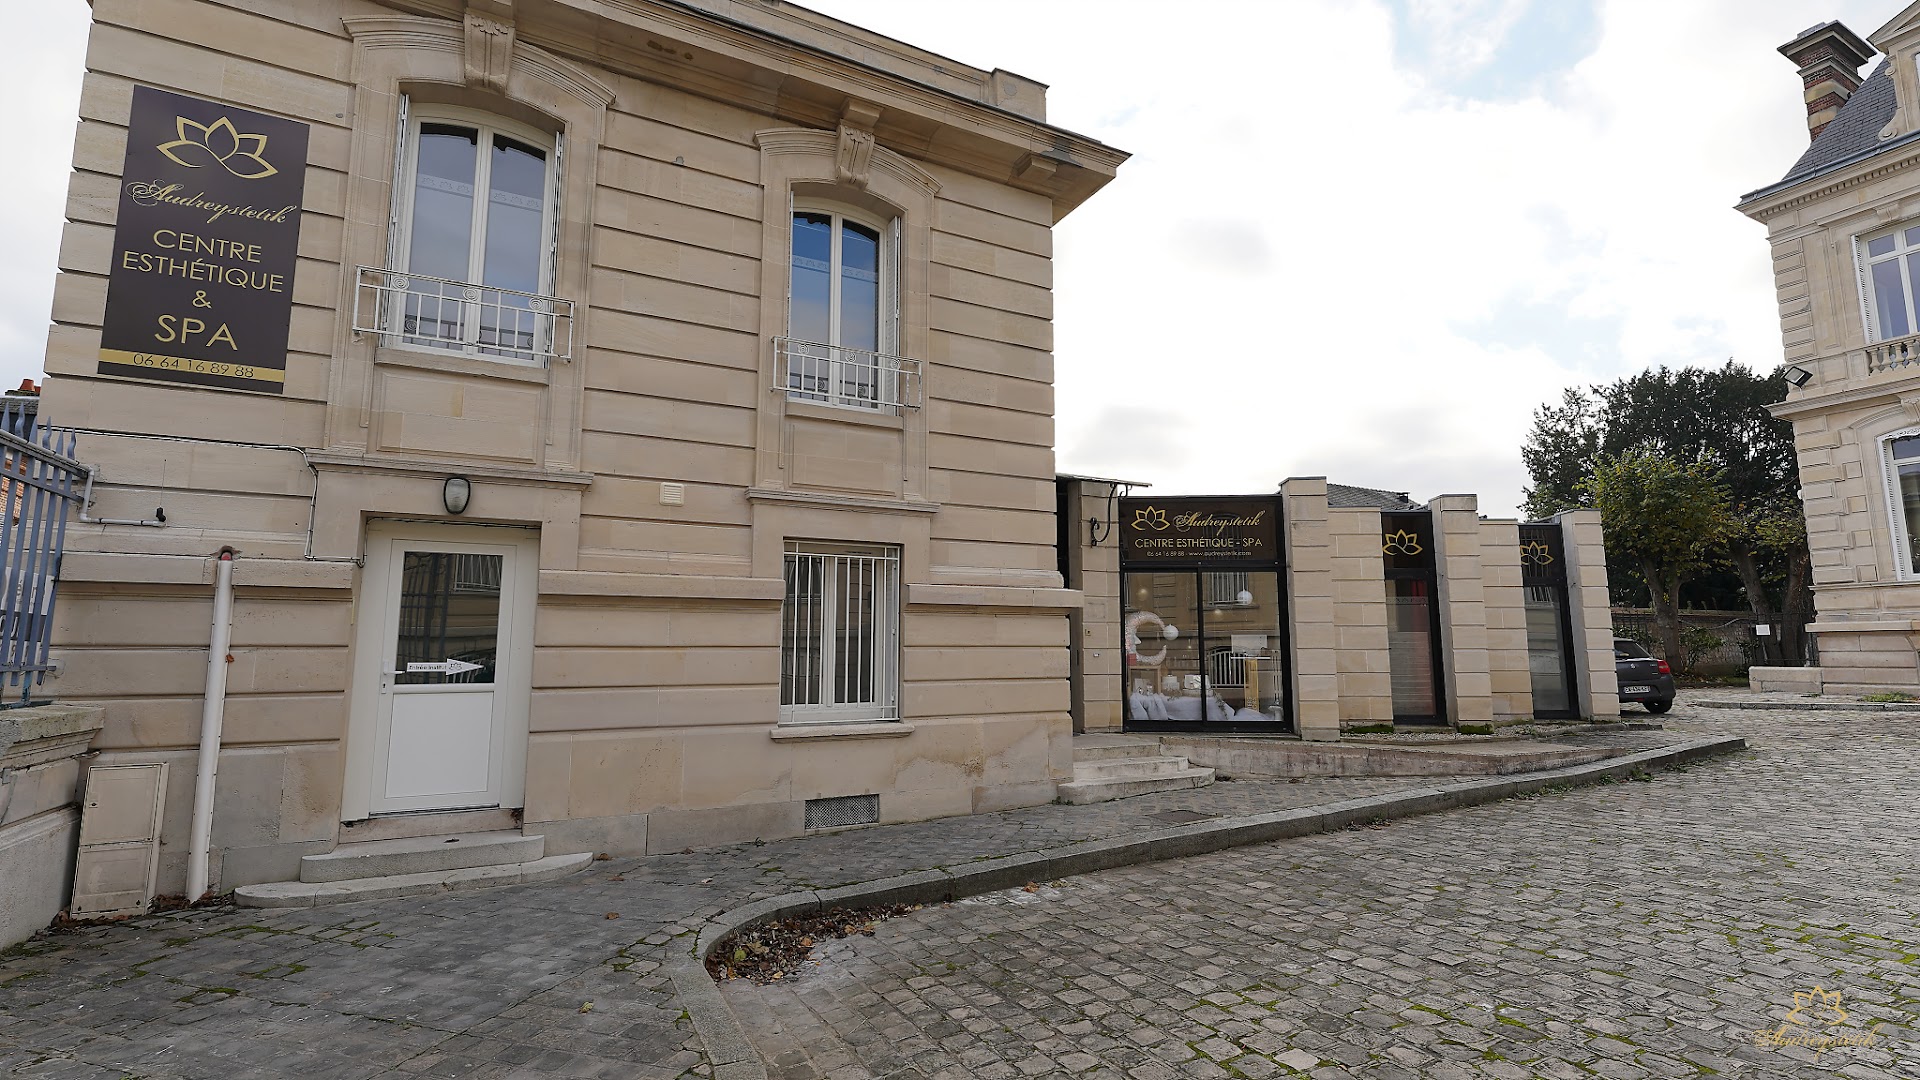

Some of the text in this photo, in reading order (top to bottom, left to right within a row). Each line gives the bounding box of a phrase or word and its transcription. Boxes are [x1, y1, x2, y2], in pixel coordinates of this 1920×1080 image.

[125, 179, 298, 224] Audreystetik
[153, 229, 262, 263] CENTRE
[123, 250, 284, 293] ESTHÉTIQUE
[192, 290, 213, 309] &
[154, 314, 238, 351] SPA
[133, 353, 254, 378] 06 64 16 89 88
[1173, 510, 1266, 536] Audreystetik
[1135, 538, 1173, 548] CENTRE
[1176, 536, 1233, 548] ESTHÉTIQUE
[1242, 537, 1263, 547] SPA
